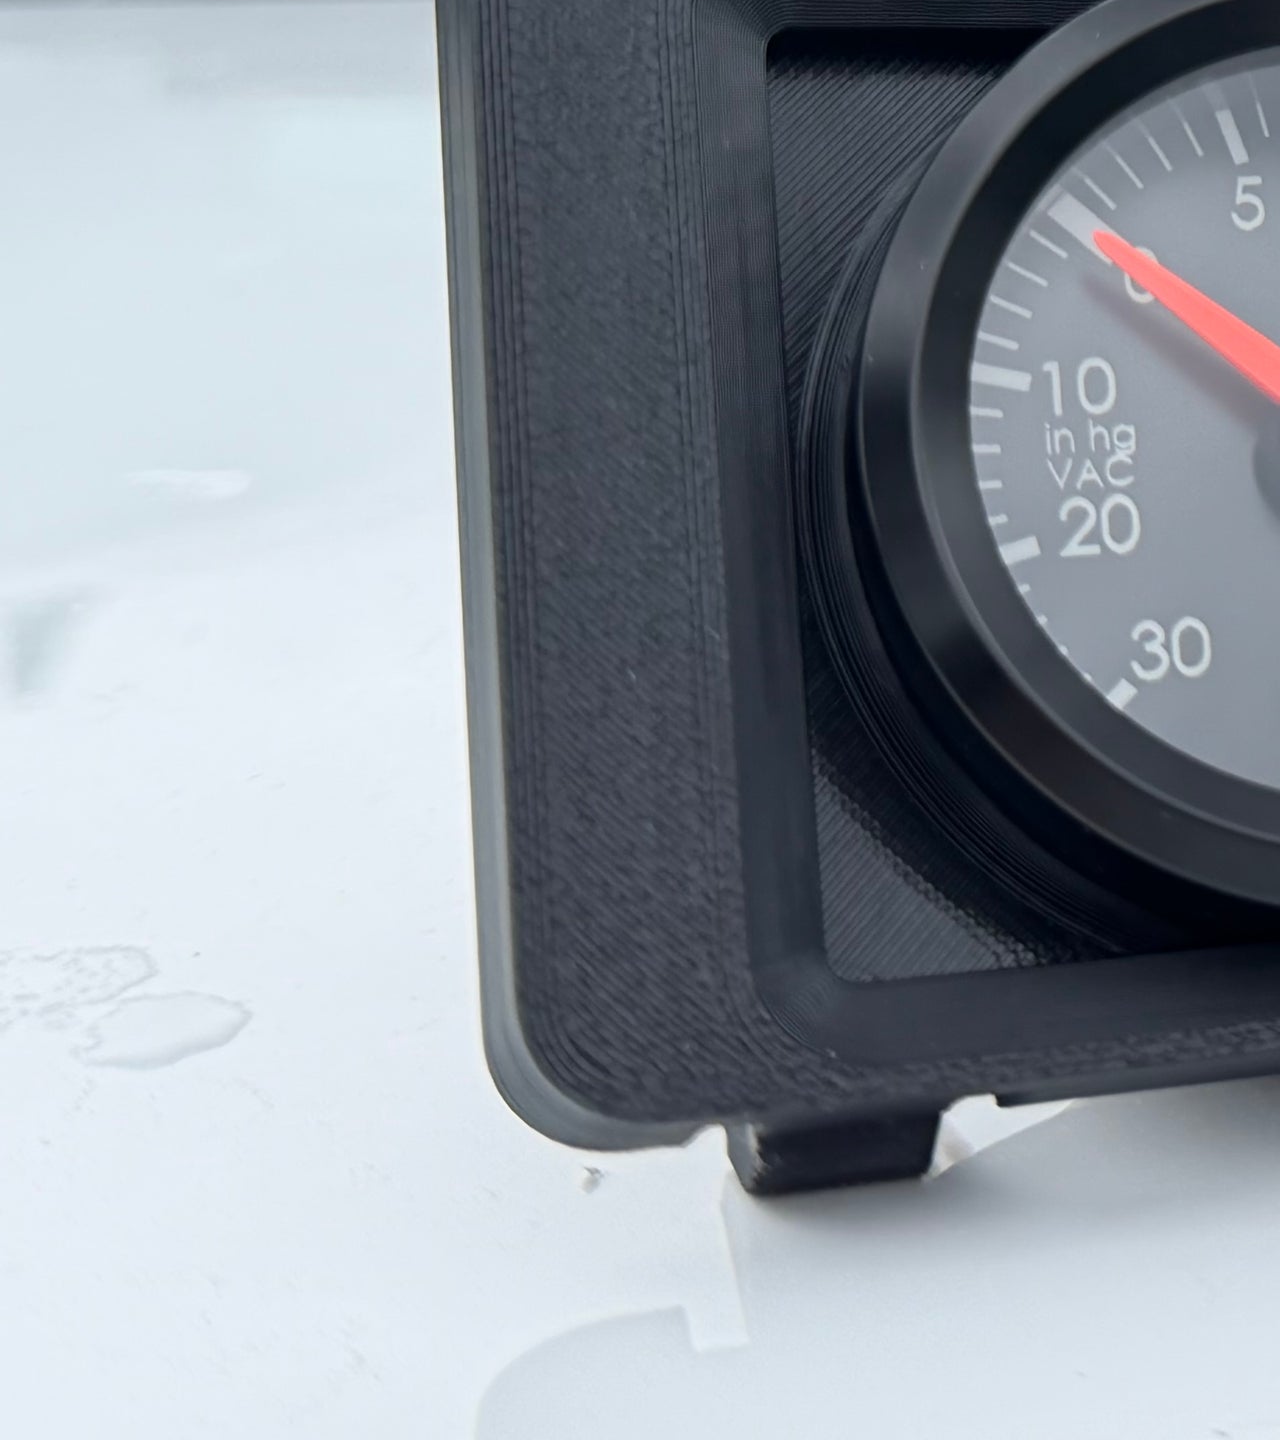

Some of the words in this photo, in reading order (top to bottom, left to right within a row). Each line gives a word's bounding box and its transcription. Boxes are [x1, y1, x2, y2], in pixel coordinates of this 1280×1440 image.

[1231, 175, 1266, 232] 5
[1042, 356, 1117, 417] 10
[1044, 422, 1076, 455] in
[1089, 418, 1137, 457] hg
[1047, 456, 1135, 490] VAC
[1059, 493, 1141, 557] 20
[1130, 616, 1212, 681] 30
